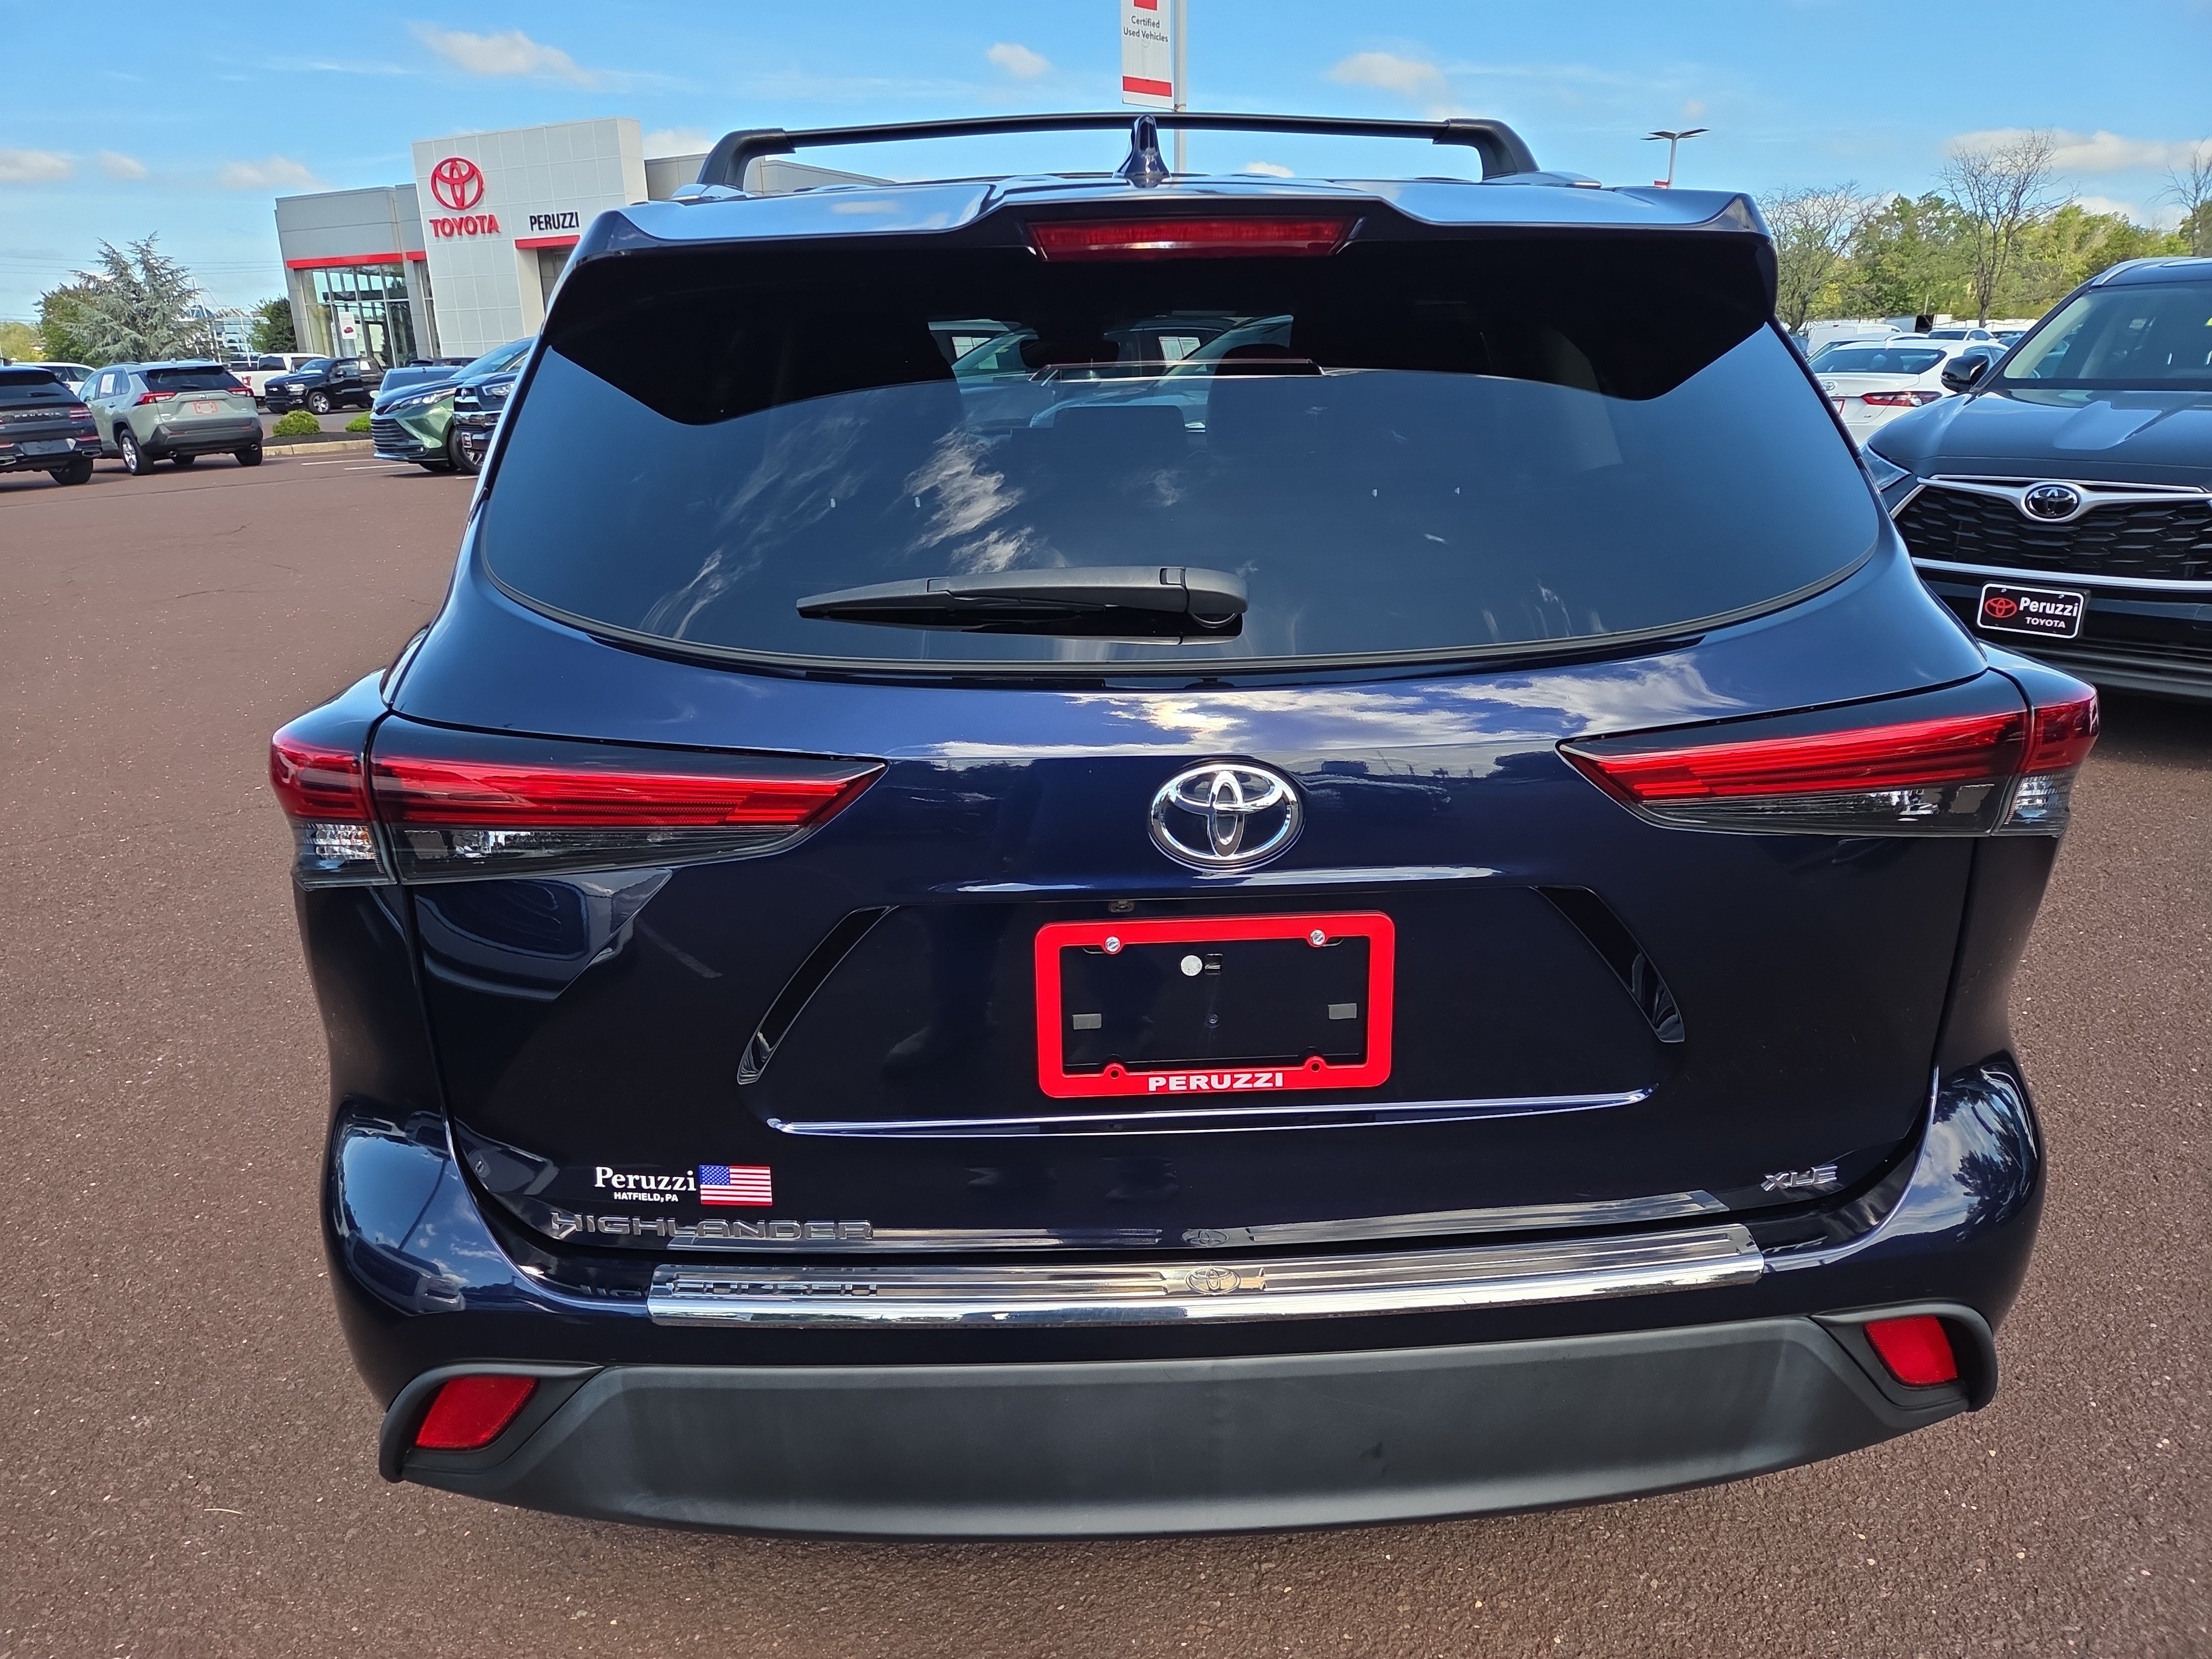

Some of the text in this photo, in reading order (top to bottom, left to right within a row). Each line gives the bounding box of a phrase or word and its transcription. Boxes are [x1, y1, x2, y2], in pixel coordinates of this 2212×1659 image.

[1131, 15, 1160, 28] Certified
[1123, 27, 1168, 42] Used Vehicles
[429, 214, 500, 237] TOYOTA
[529, 211, 580, 232] PERUZZI
[2019, 597, 2079, 617] Peruzzi
[2025, 617, 2066, 628] TOYOTA
[1148, 1072, 1283, 1091] PERUZZI
[594, 1166, 697, 1191] Peruzzi
[550, 1212, 874, 1240] HIGHLANDER
